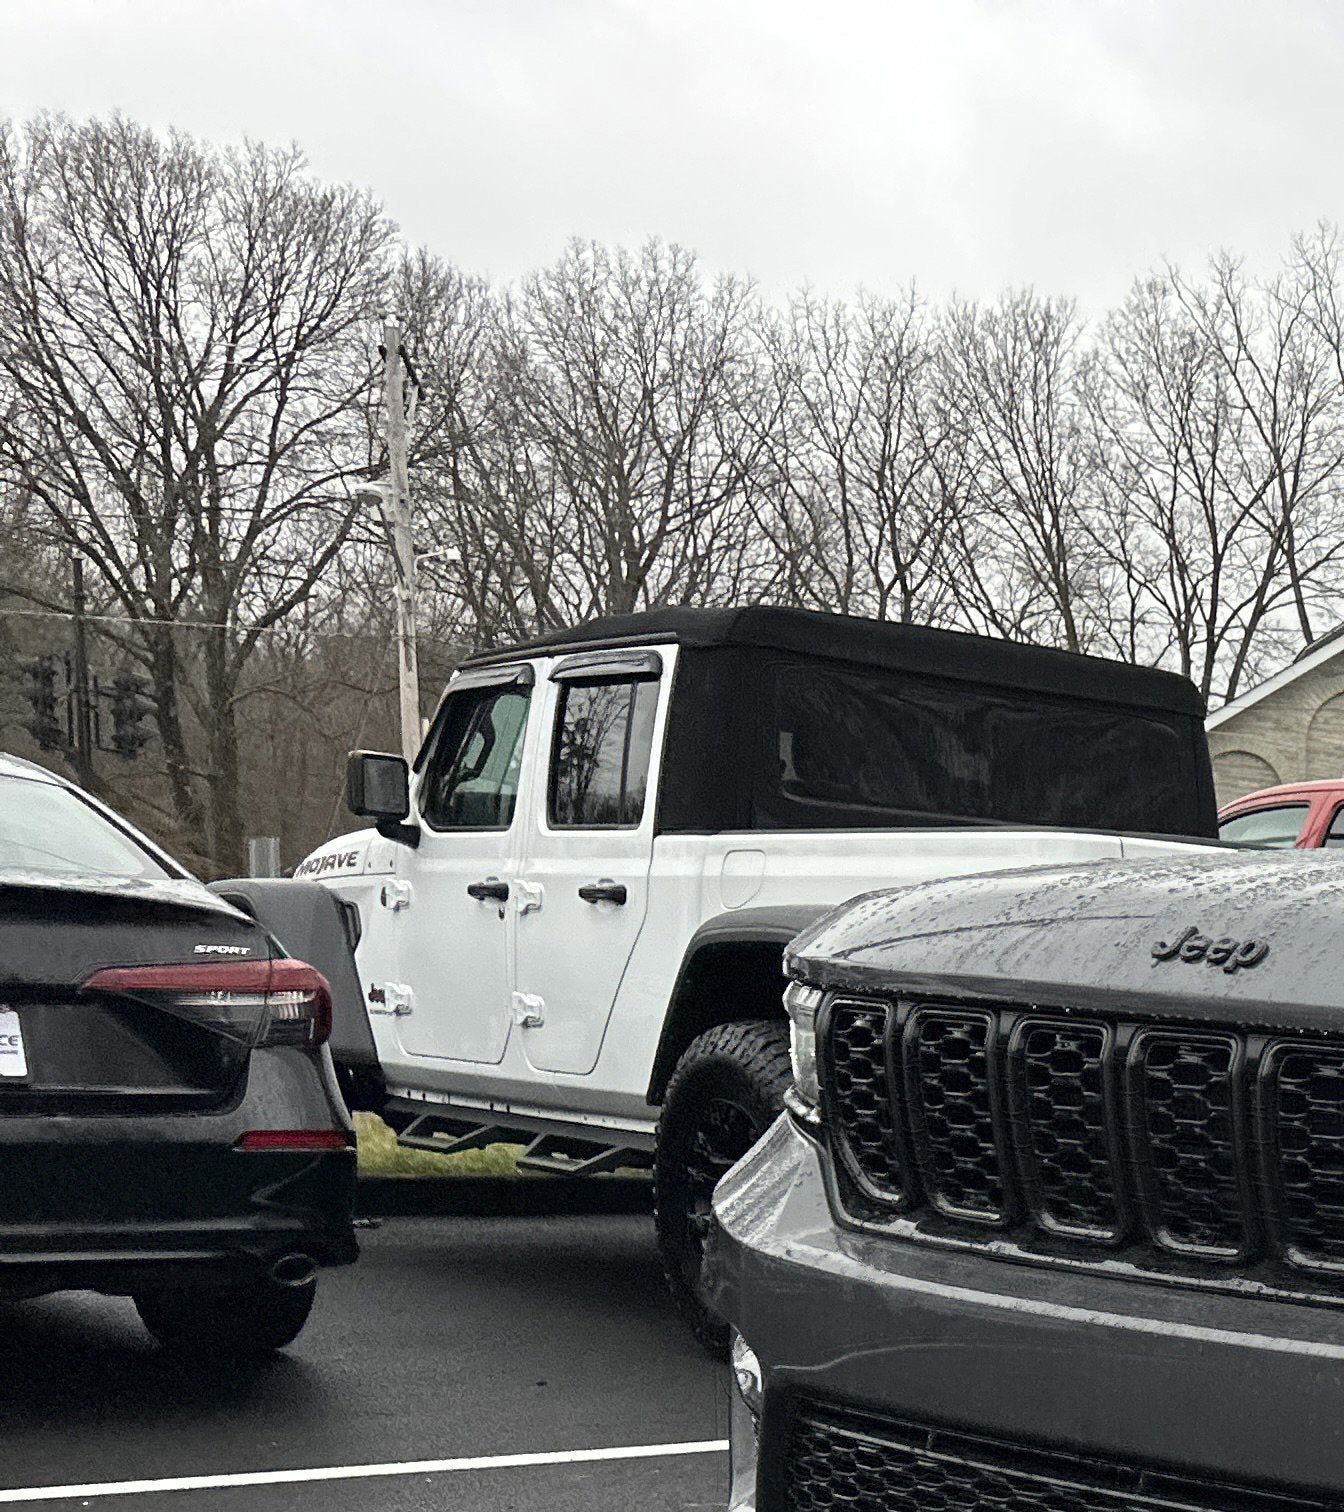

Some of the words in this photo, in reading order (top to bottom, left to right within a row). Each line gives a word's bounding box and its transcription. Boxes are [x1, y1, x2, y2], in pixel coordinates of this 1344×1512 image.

[295, 850, 359, 878] MOJAVE
[193, 944, 251, 955] SPORT
[1151, 926, 1270, 974] Jeep
